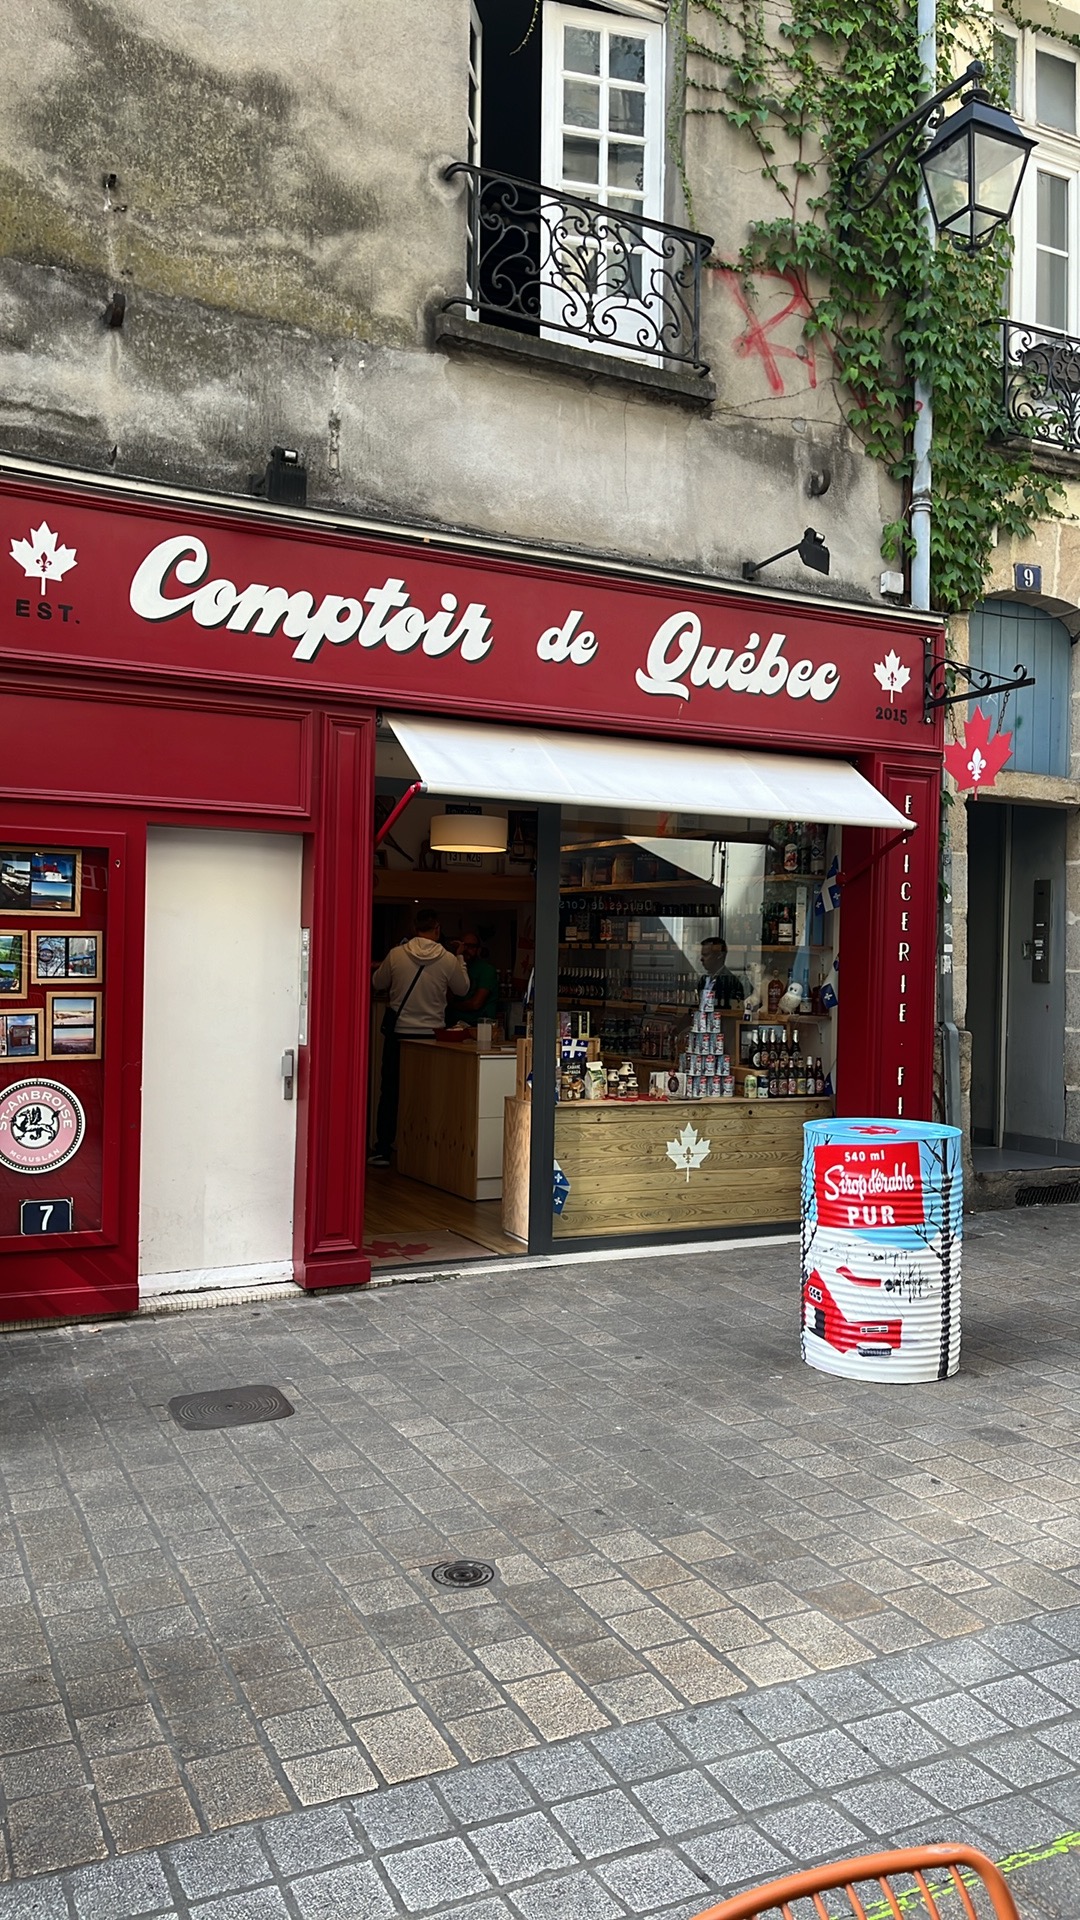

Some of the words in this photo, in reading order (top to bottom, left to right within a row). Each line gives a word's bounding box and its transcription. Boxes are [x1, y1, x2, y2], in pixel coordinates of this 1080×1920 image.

[1024, 569, 1034, 588] 9
[15, 599, 80, 625] EST.
[129, 535, 494, 662] Comptoir
[536, 609, 598, 665] de
[635, 610, 841, 702] Québec
[875, 706, 909, 725] 2015
[898, 795, 912, 1023] EICERIE
[0, 1090, 73, 1131] ST-AMBROISE
[844, 1151, 866, 1162] 540
[870, 1149, 885, 1161] ml
[824, 1164, 868, 1201] Sirop
[39, 1205, 54, 1231] 7
[847, 1205, 896, 1226] PUR
